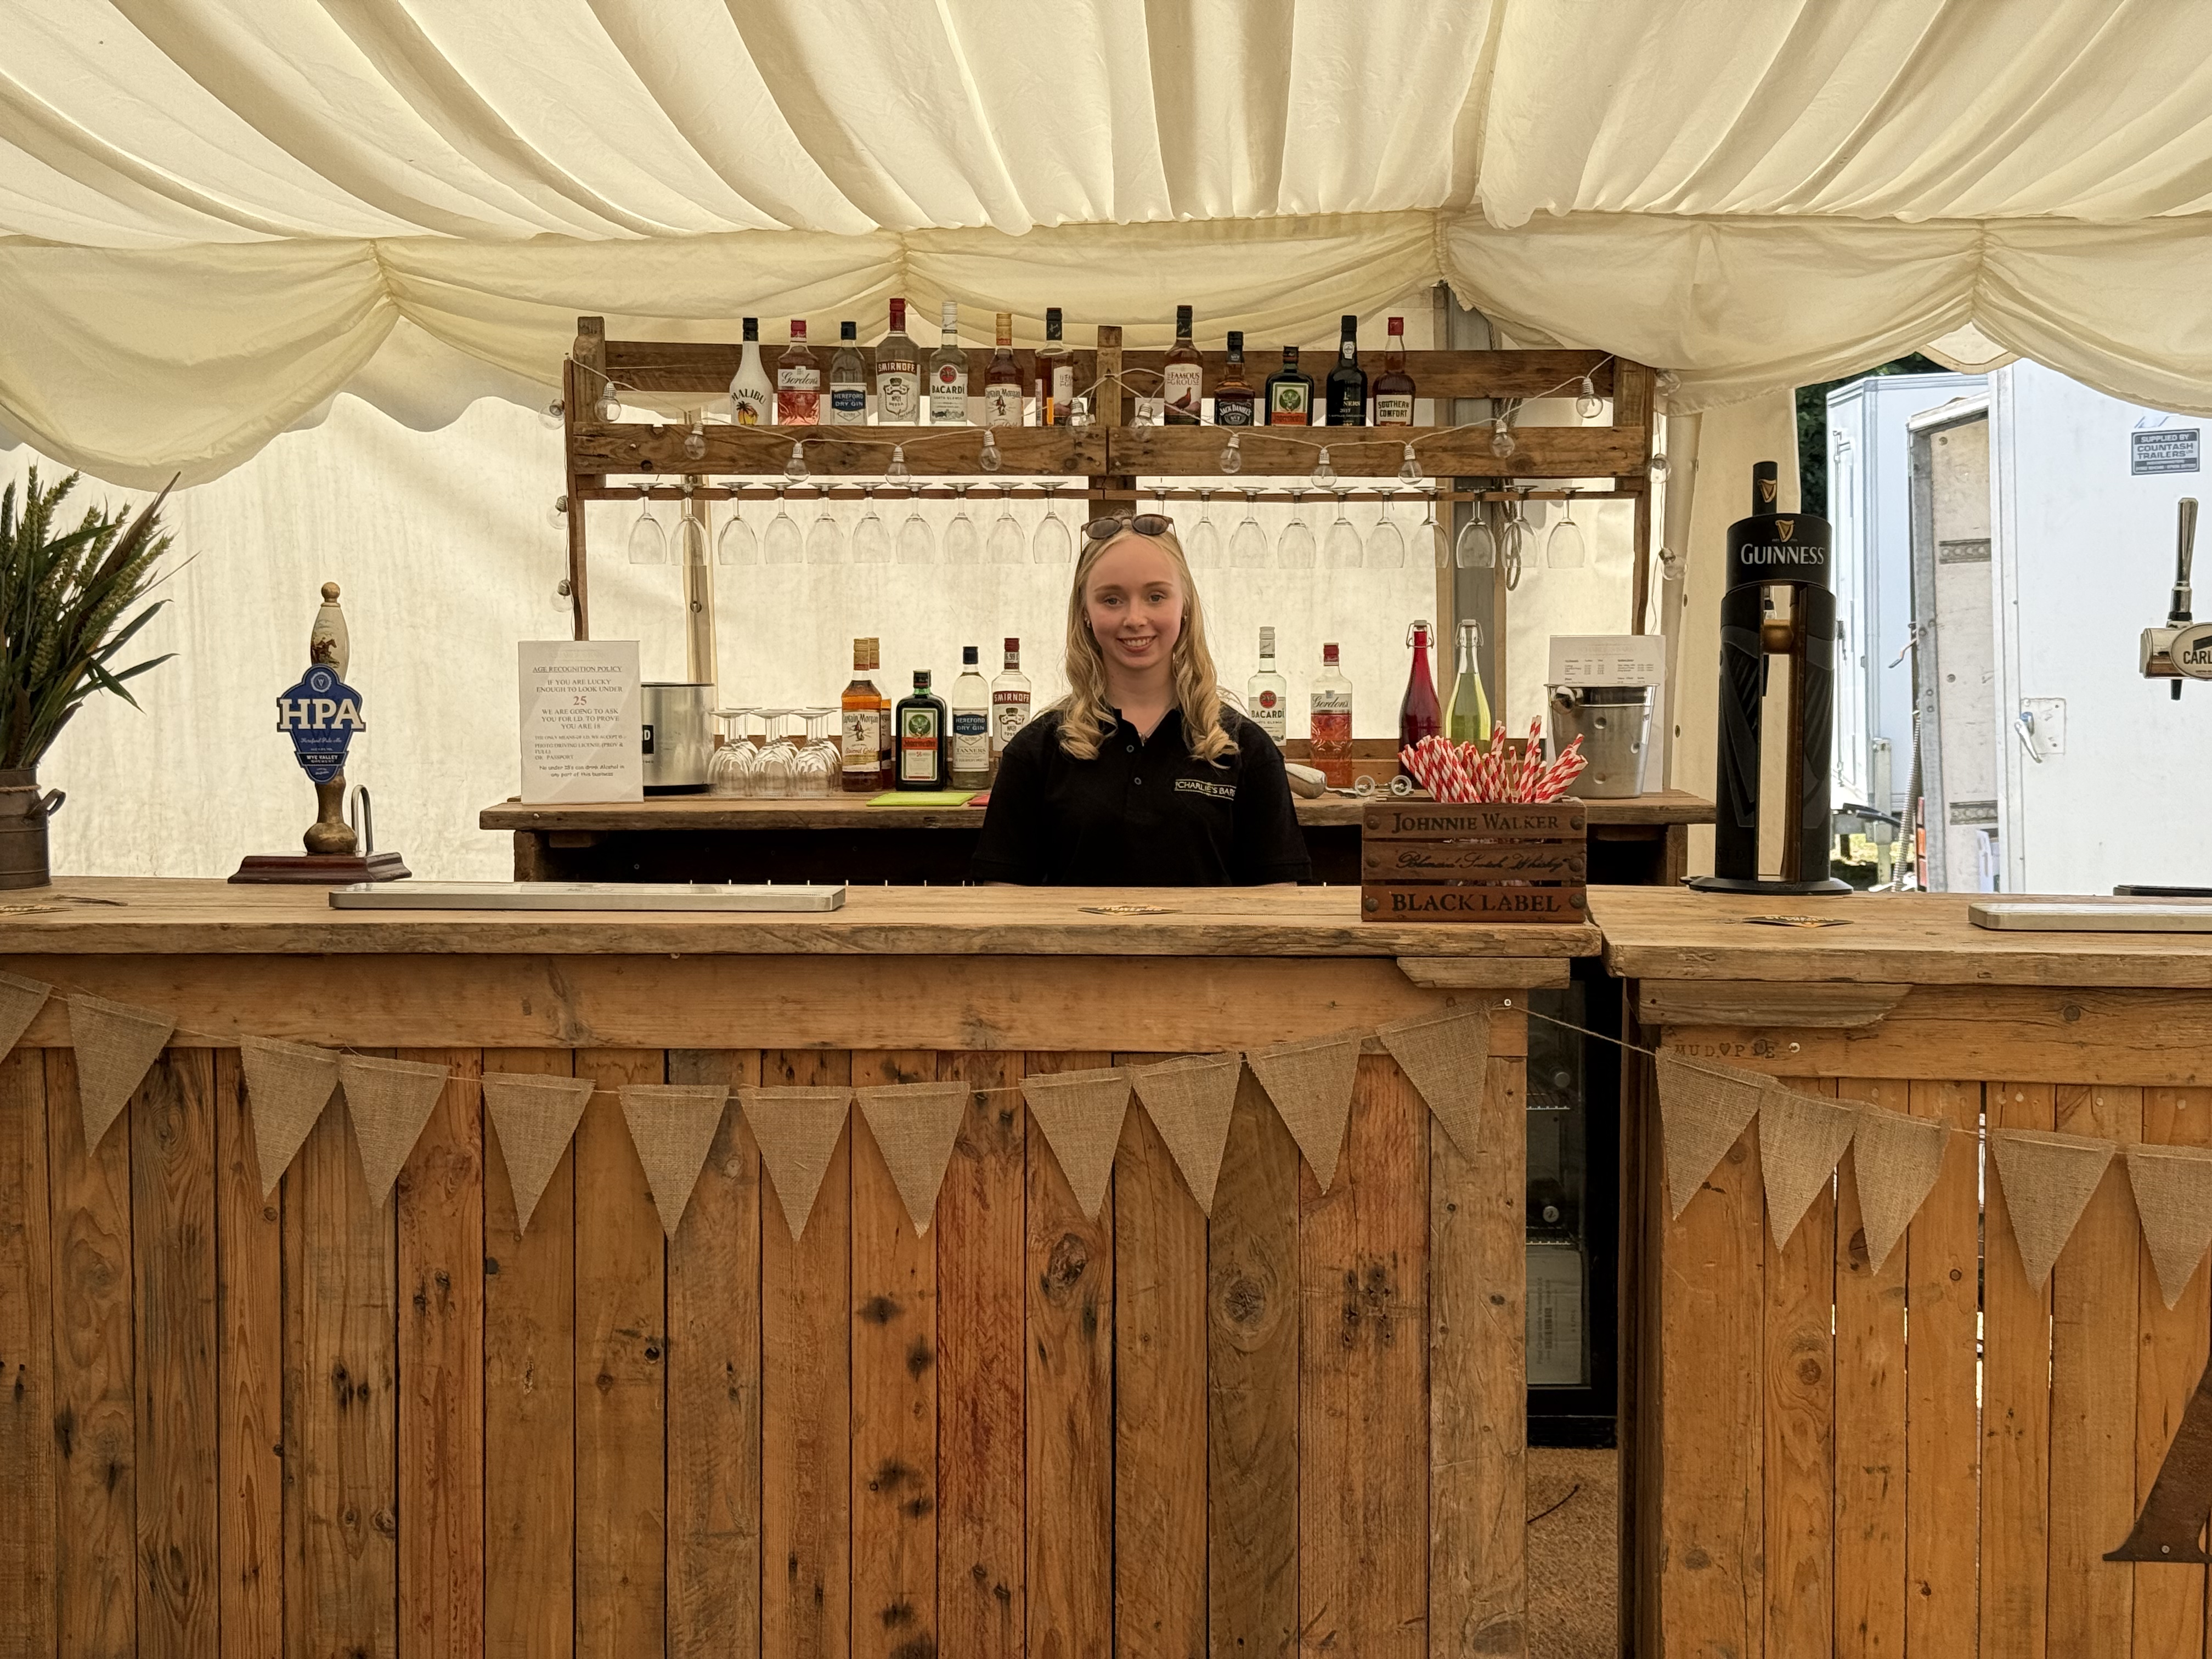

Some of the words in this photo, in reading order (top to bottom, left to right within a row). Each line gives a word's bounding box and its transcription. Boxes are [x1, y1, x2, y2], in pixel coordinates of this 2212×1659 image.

[781, 371, 818, 385] Gordon's
[732, 388, 766, 405] MALIBU
[1378, 400, 1410, 409] SOUTHERN
[1219, 406, 1232, 416] JACK
[2141, 435, 2177, 443] SUPPLIED
[2137, 443, 2193, 452] COUNTASH
[2137, 450, 2186, 460] TRAILERS
[1741, 543, 1826, 565] GUINNESS
[573, 696, 588, 706] 25
[994, 693, 1030, 703] SMIRNOFF
[1312, 696, 1349, 708] Gordon's
[279, 699, 364, 729] HPA
[859, 714, 878, 724] Morgan
[1178, 781, 1218, 794] CHARLIE'S
[1392, 812, 1477, 834] JOHNNIE
[1481, 813, 1559, 830] WALKER
[1391, 894, 1476, 912] BLACK
[1481, 894, 1562, 912] LABEL
